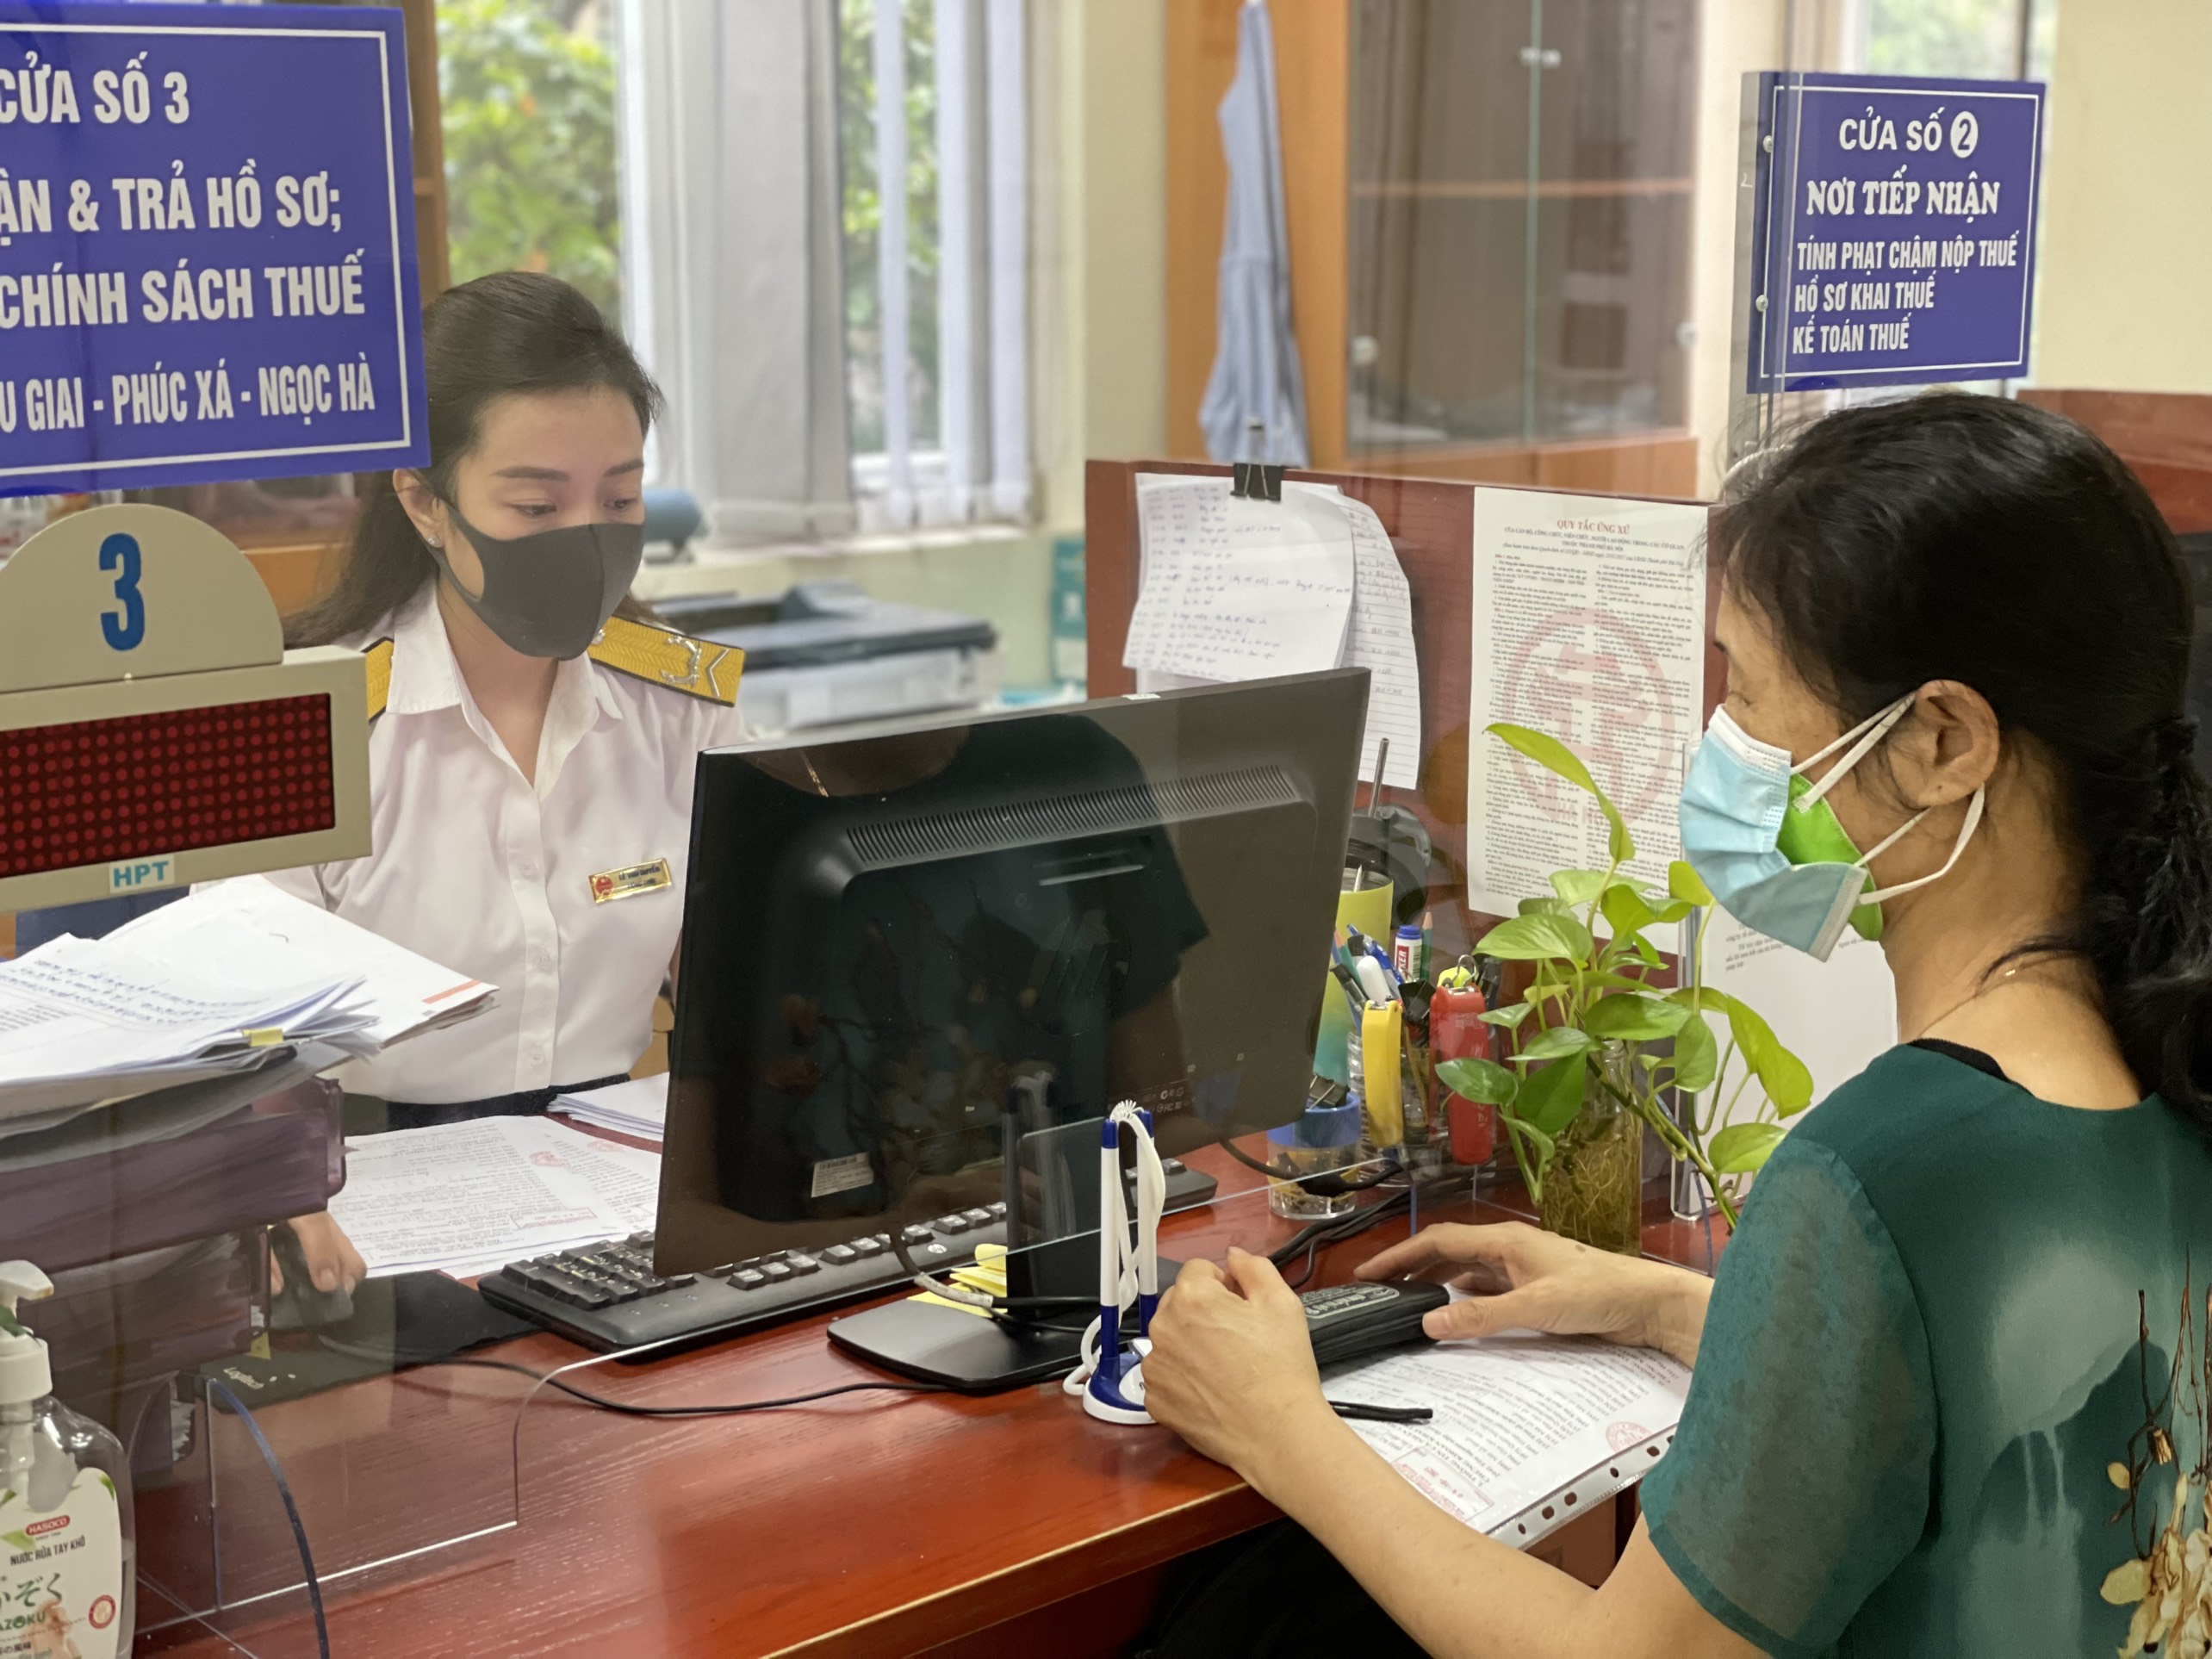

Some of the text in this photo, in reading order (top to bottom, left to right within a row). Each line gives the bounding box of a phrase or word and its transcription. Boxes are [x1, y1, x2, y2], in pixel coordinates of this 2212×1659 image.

[0, 52, 190, 124] CỬA SỐ 3
[1840, 106, 1974, 154] CỬA SỐ 2
[69, 180, 100, 233] &
[113, 160, 196, 230] TRẢ
[207, 159, 262, 228] HỒ
[276, 171, 342, 233] SƠ;
[1806, 165, 2000, 224] NƠI TIẾP NHẬN
[1798, 231, 2020, 276] TÍNH PHẠT CHẬM NỘP THUẾ
[0, 249, 366, 329] CHÍNH SÁCH THUẾ
[1795, 270, 1937, 313] HỒ SƠ KHAI THUẾ
[1793, 313, 1913, 354] KẾ TOÁN THUẾ
[26, 377, 85, 431] GIAI
[113, 362, 188, 425] PHÚC
[196, 359, 235, 420] XÁ
[259, 365, 332, 425] NGỌC
[339, 352, 376, 411] HÀ
[1557, 519, 1575, 529] QUY
[1578, 519, 1594, 531] TẮC
[99, 532, 146, 651] 3
[113, 861, 170, 888] HPT
[28, 1518, 67, 1534] HASOCO
[53, 1543, 68, 1555] TAY
[71, 1535, 85, 1550] KHÔ
[0, 1573, 63, 1607] ぞく
